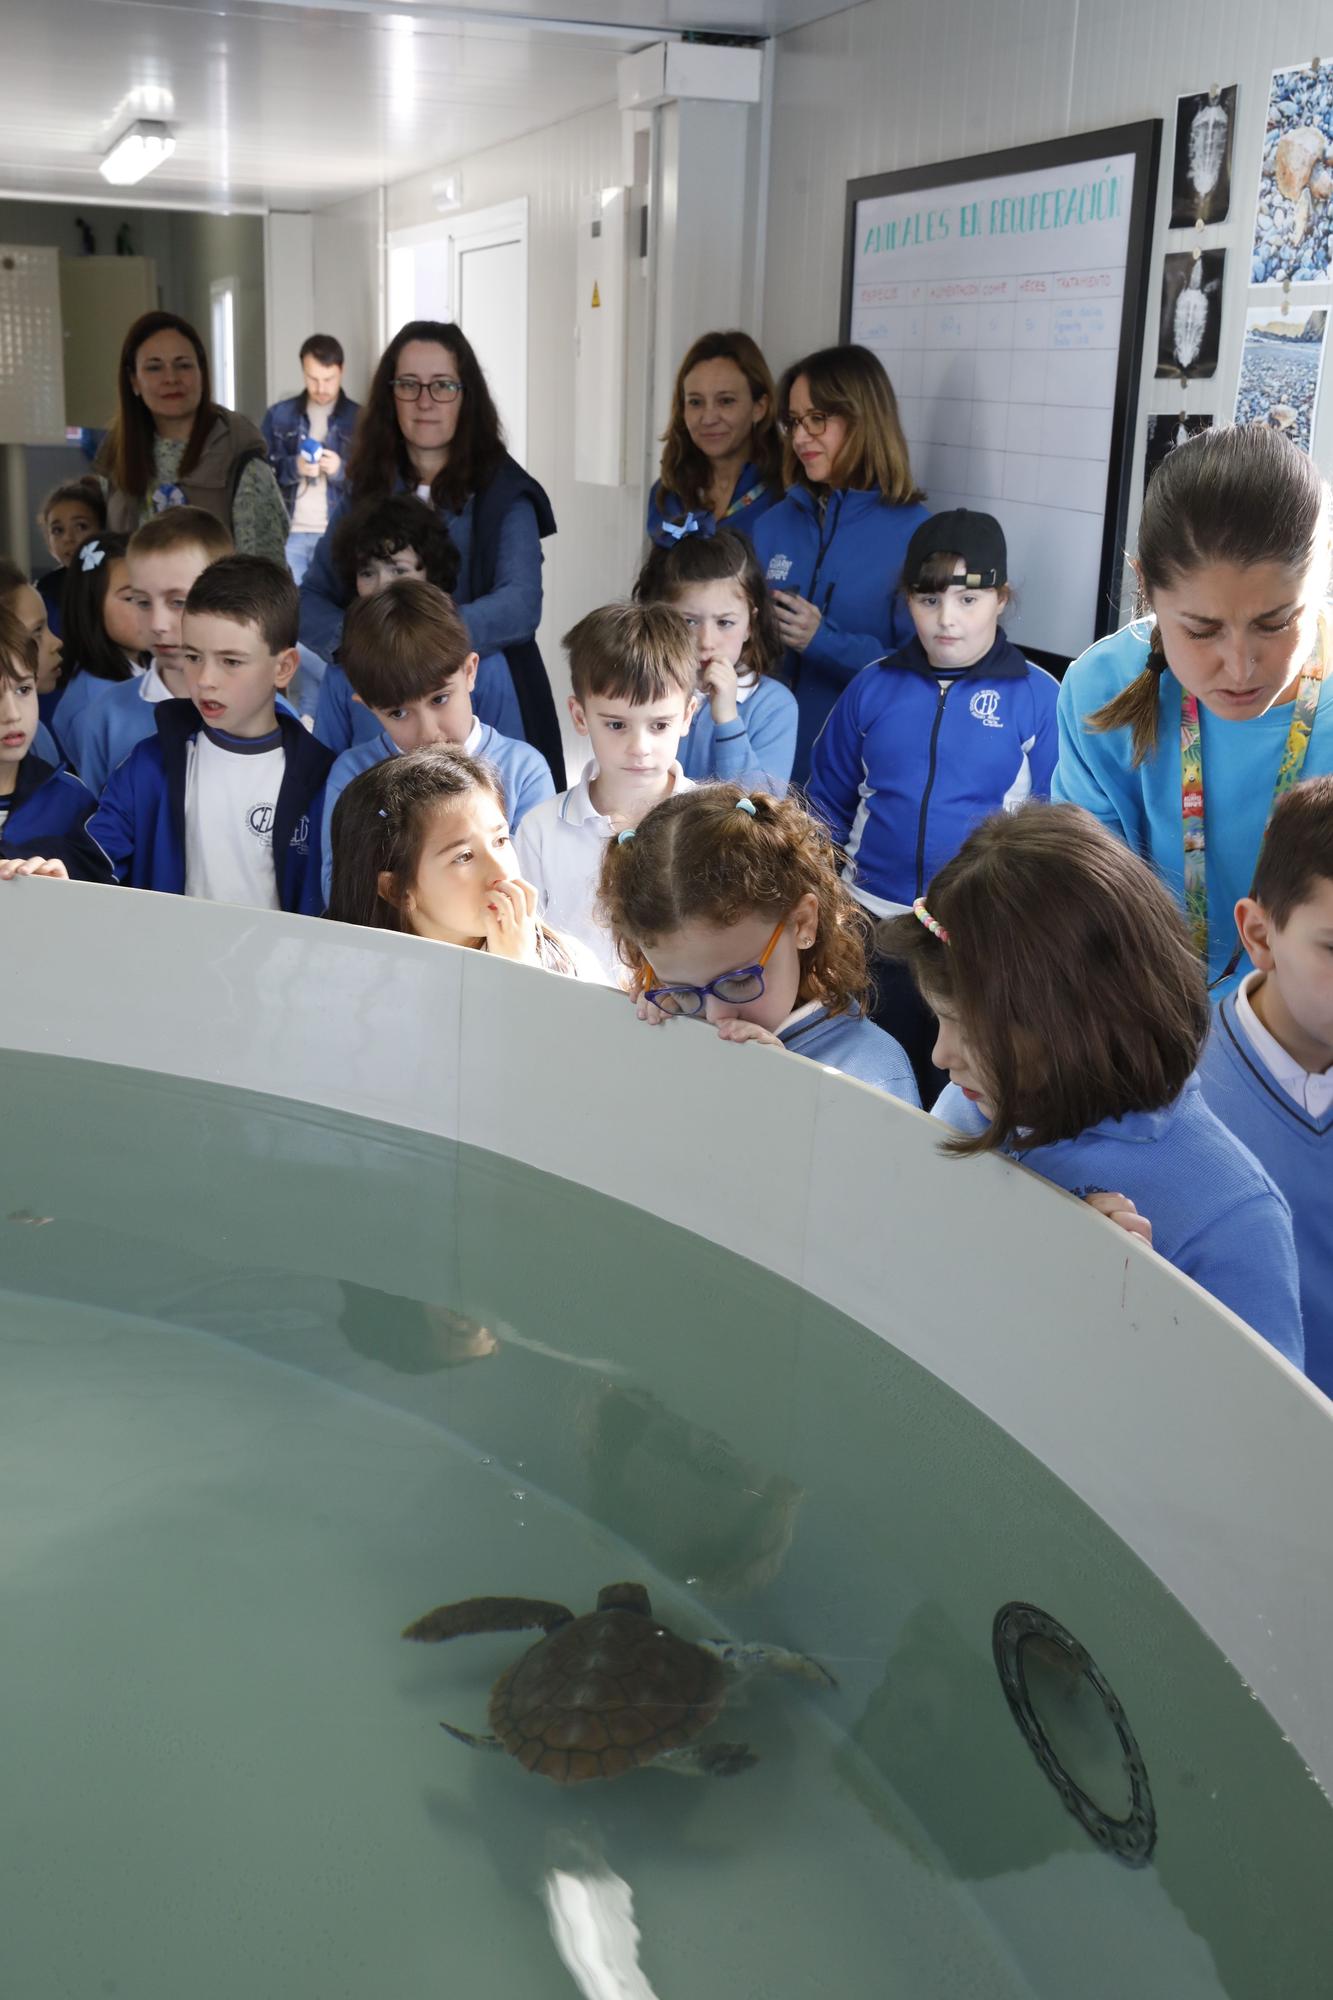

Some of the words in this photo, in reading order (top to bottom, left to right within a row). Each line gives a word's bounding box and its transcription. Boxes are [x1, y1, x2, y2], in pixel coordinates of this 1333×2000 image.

[863, 209, 951, 255] ANIMALES
[960, 202, 983, 237] EN
[989, 165, 1124, 235] RECUPERACIÓN
